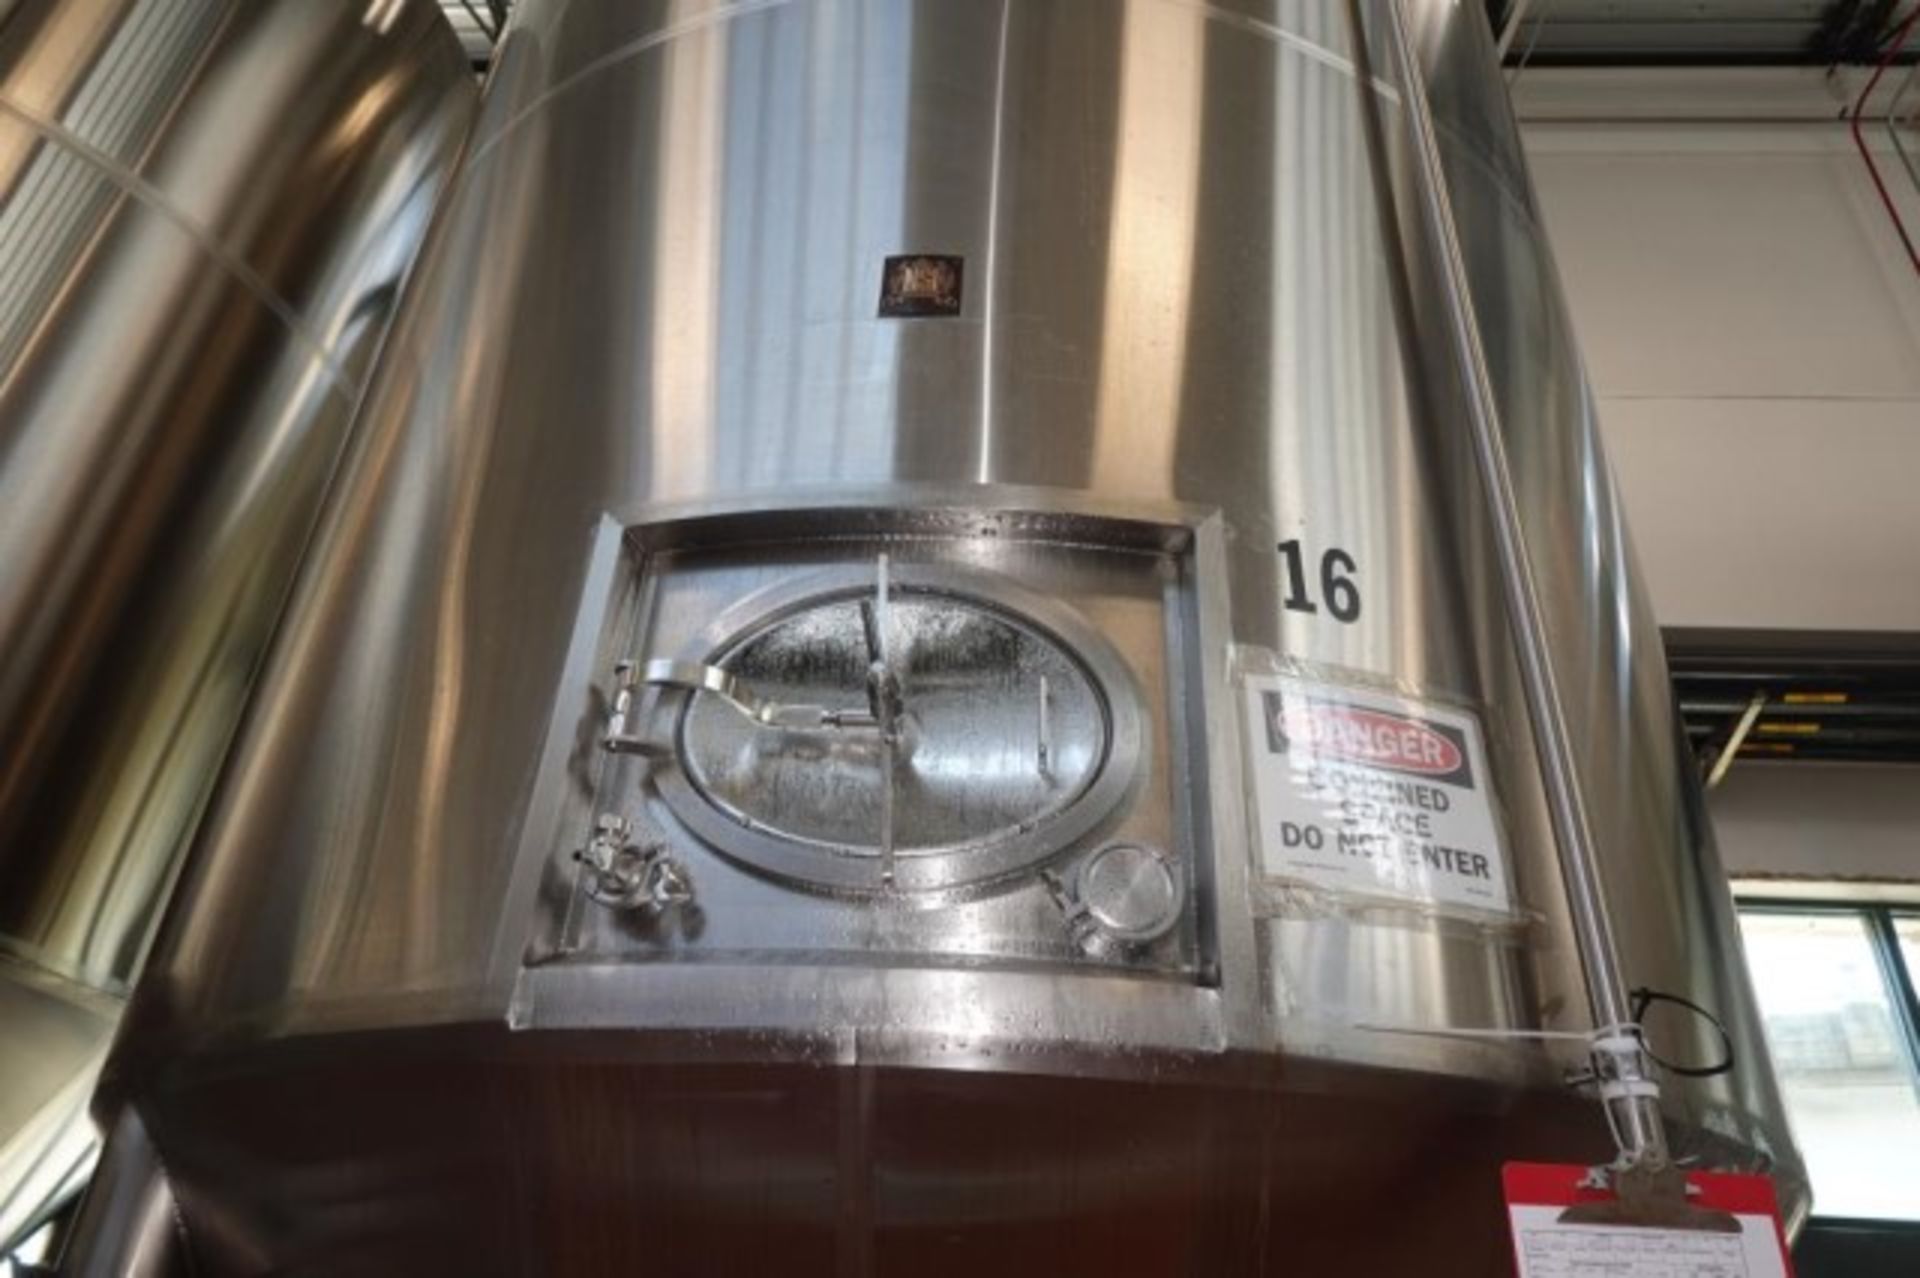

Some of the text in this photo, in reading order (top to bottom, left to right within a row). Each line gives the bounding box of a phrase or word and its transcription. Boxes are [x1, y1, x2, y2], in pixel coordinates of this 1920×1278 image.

[1277, 539, 1362, 623] 16
[1302, 713, 1445, 768] DANGER
[1281, 821, 1491, 880] DO NOT ENTER
